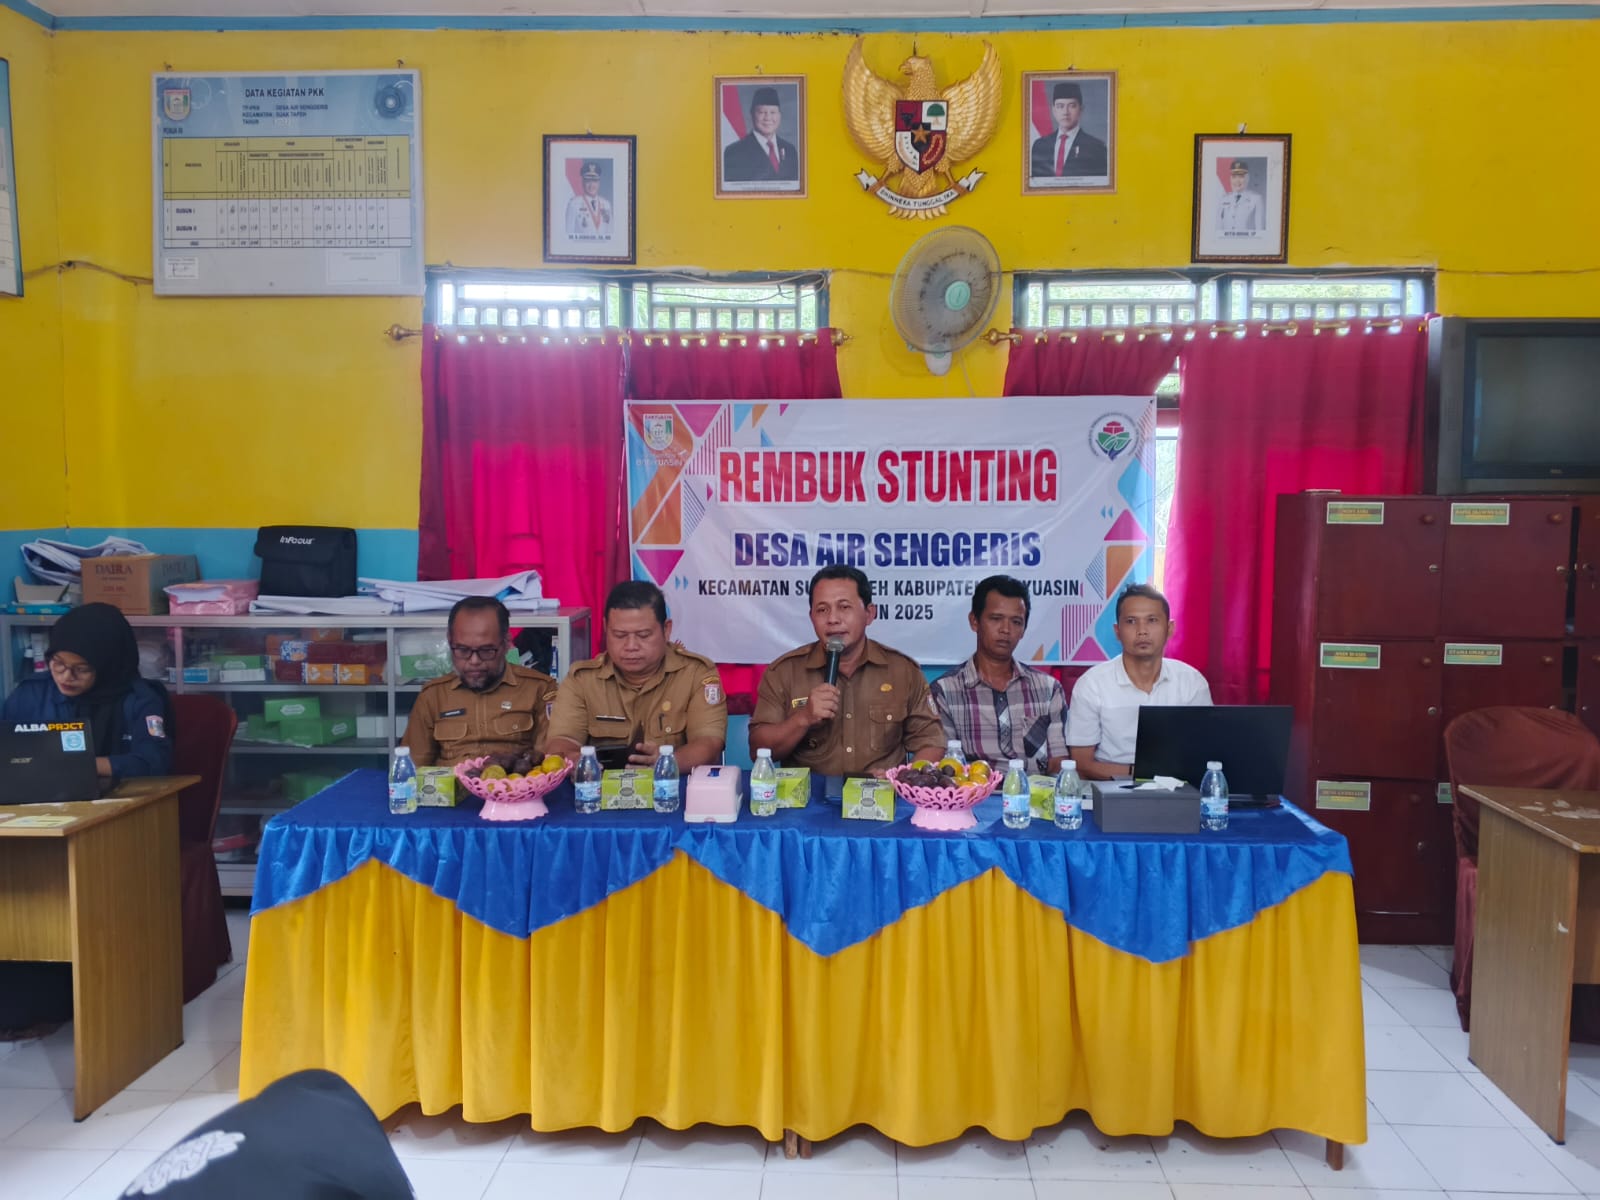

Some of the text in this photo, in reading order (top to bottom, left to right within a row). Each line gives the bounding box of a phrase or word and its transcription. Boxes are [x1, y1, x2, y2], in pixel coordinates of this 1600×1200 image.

[245, 88, 325, 97] DATA KEGIATAN PKK
[719, 448, 1058, 504] REMBUK STUNTING
[734, 531, 1042, 568] DESA AIR SENGGERIS
[698, 579, 790, 596] KECAMATAN
[894, 580, 979, 596] KABUPATE
[1022, 580, 1080, 596] YUASIN
[894, 604, 934, 620] 2025
